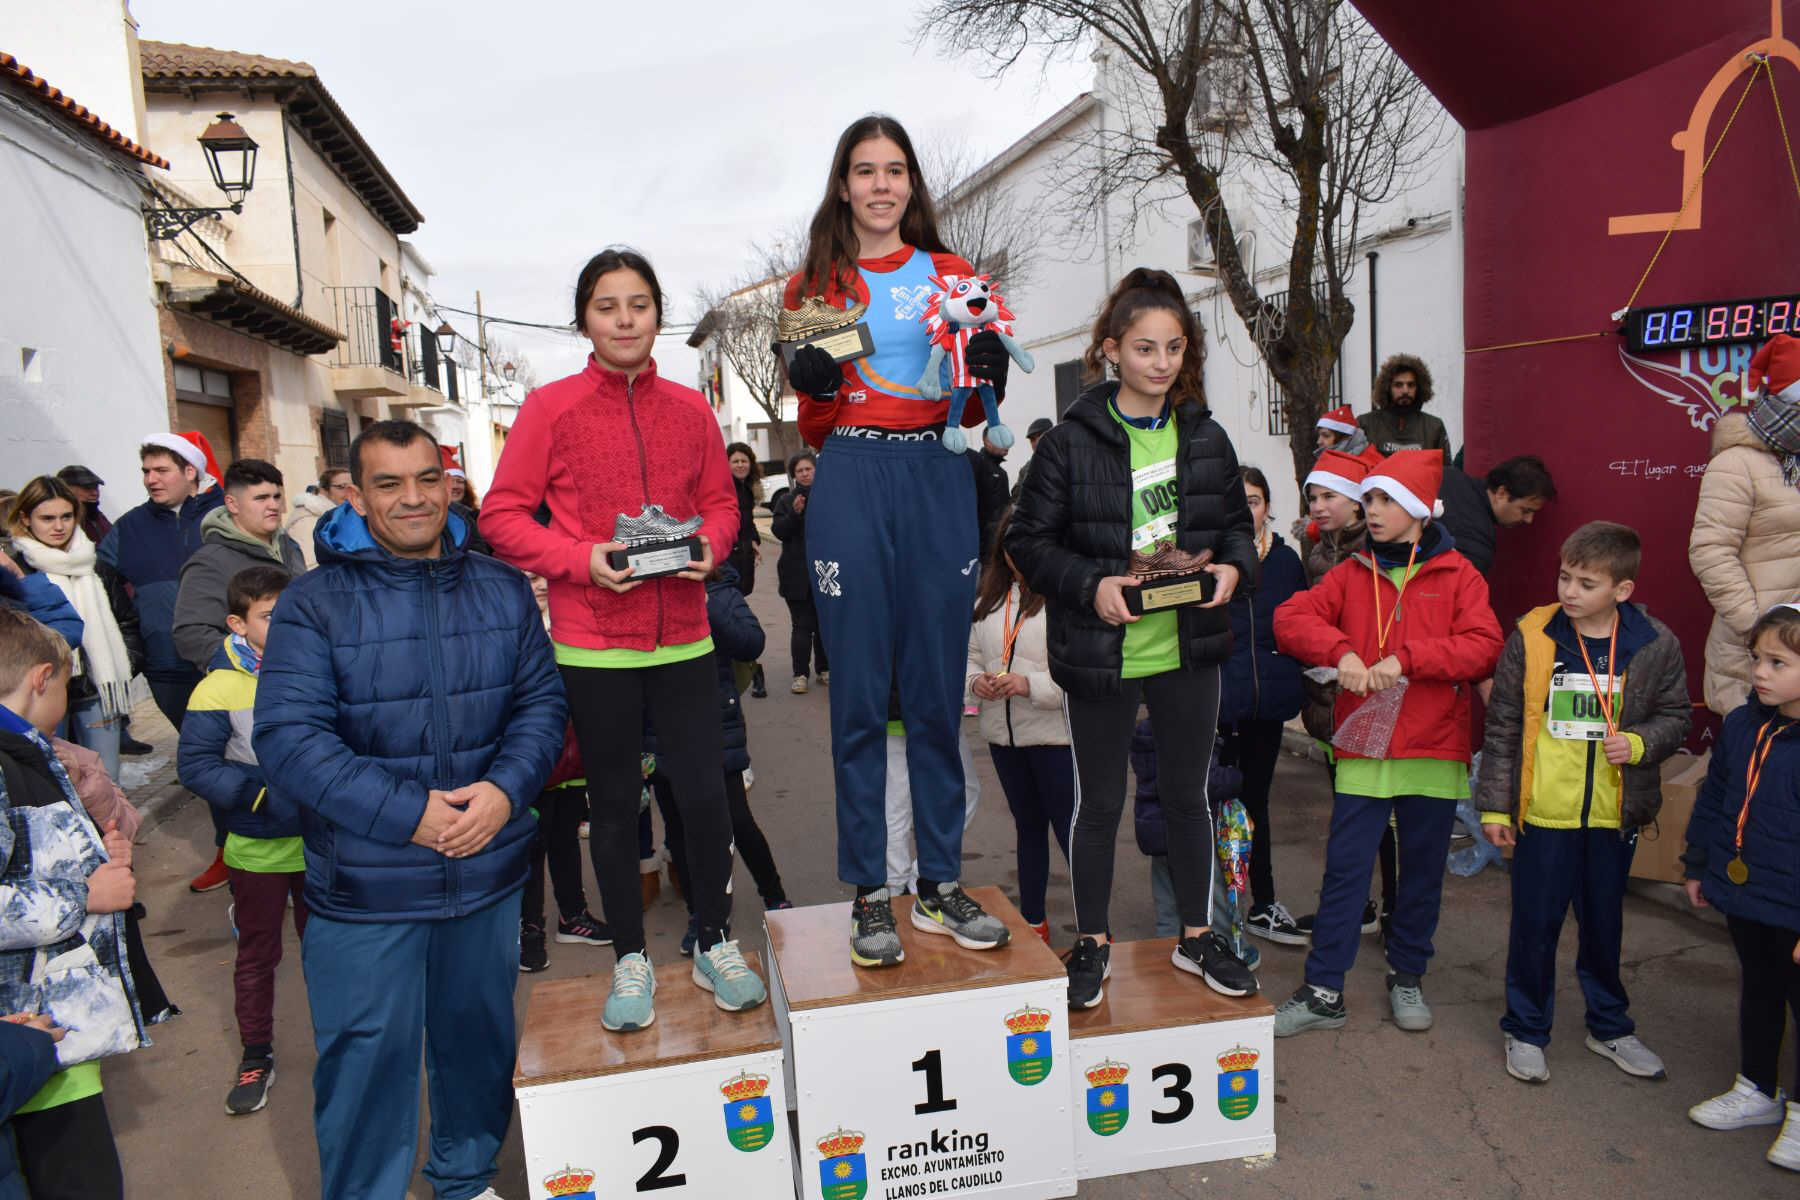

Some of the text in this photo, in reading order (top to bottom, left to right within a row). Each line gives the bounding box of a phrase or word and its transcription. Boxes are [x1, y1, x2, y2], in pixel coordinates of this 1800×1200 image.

[1680, 343, 1766, 377] TUR
[1645, 459, 1677, 480] lugar
[911, 1049, 957, 1115] 1
[1151, 1062, 1194, 1125] 3
[631, 1124, 687, 1193] 2
[887, 1128, 989, 1161] ranking
[881, 1150, 1005, 1181] EXCMO. AYUNTAMIENTO
[886, 1170, 1003, 1200] LLANOS DEL CAUDILLO
